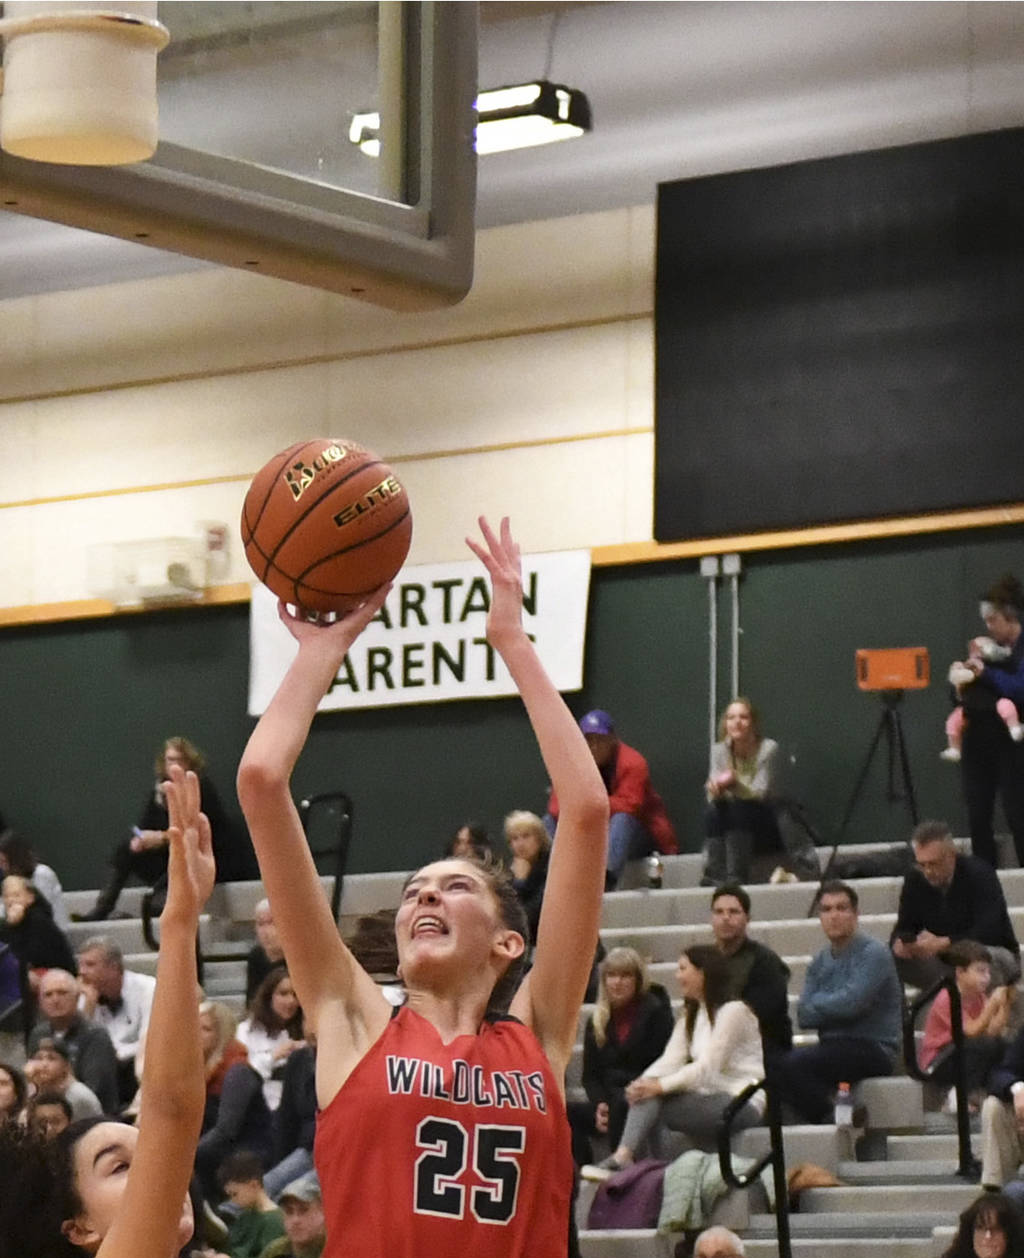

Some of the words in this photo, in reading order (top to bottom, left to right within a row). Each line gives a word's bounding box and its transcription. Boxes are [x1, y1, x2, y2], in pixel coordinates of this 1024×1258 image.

[333, 476, 401, 527] ELITE
[372, 571, 538, 630] ARTAN
[328, 634, 536, 695] ARENT
[386, 1055, 548, 1115] WILDCATS
[413, 1115, 526, 1226] 25
